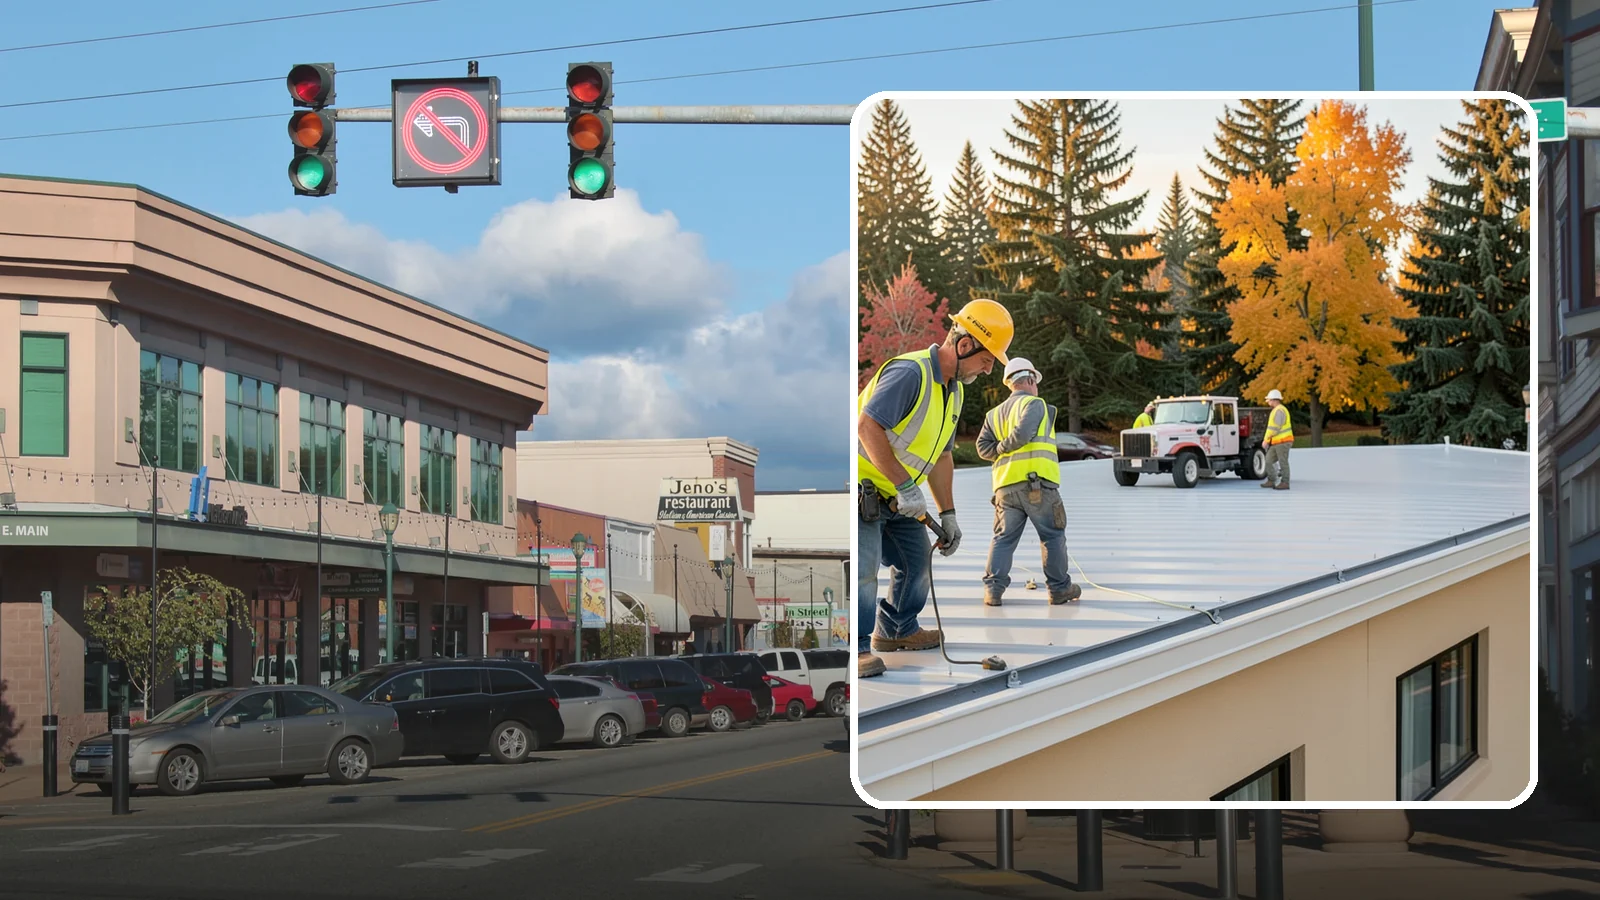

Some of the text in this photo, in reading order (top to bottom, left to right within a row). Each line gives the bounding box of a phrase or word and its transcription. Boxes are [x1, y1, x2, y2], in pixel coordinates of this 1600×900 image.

[669, 480, 727, 494] Jeno's
[665, 496, 731, 509] restaurant
[658, 510, 681, 519] Italian
[686, 509, 715, 519] American
[715, 509, 738, 519] Cuisine
[2, 525, 49, 536] E. MAIN
[797, 607, 829, 616] Street
